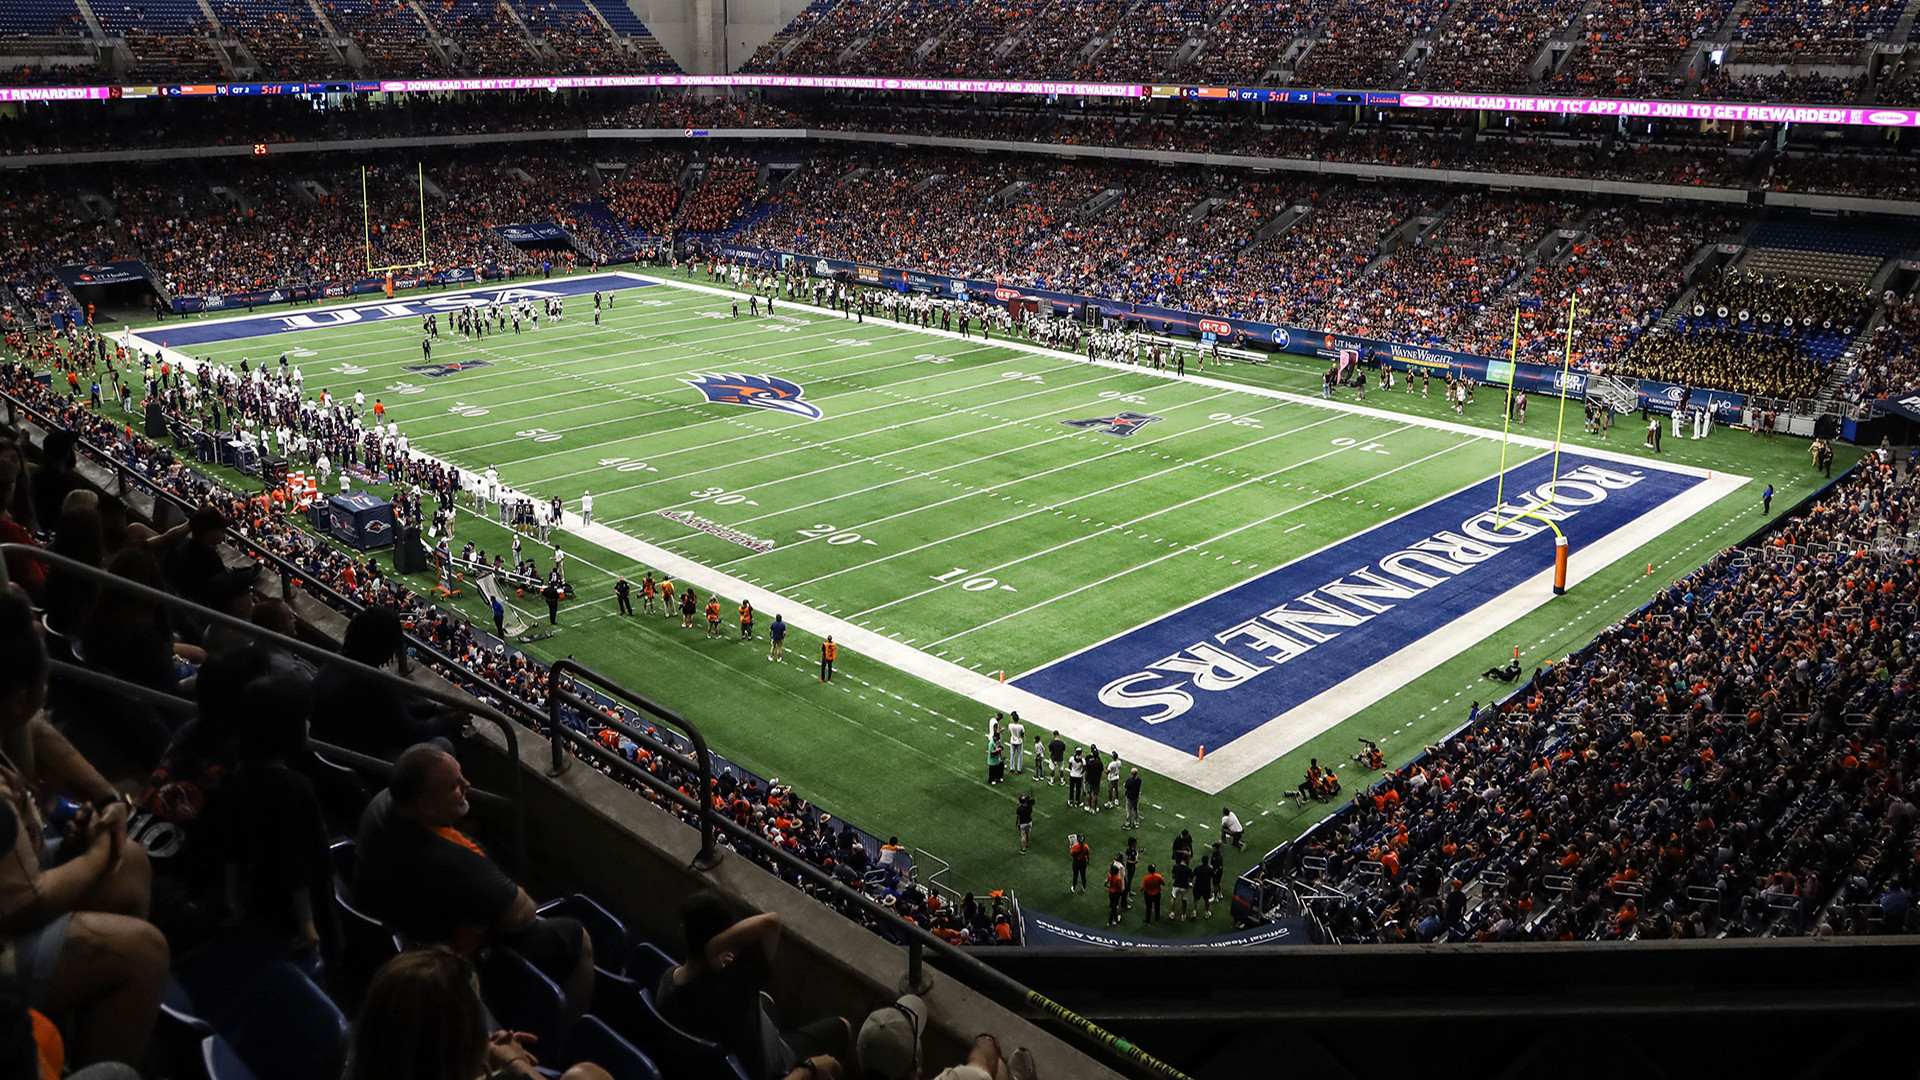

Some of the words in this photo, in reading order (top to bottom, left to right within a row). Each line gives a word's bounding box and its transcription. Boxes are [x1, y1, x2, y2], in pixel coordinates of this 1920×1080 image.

[408, 80, 460, 90] DOWNLOAD
[462, 80, 480, 89] THE
[482, 80, 496, 88] MY
[515, 80, 532, 88] APP
[534, 79, 550, 87] AND
[552, 78, 572, 86] JOIN
[572, 78, 584, 86] TO
[585, 78, 601, 86] GET
[602, 78, 648, 86] REWARDED!
[680, 76, 732, 84] DOWNLOAD
[734, 76, 750, 84] THE
[752, 76, 761, 84] MY
[773, 77, 784, 86] APP
[786, 78, 798, 86] AND
[799, 78, 814, 86] JOIN
[837, 80, 876, 88] REWARDED!
[902, 80, 942, 90] DOWNLOAD
[944, 81, 958, 90] THE
[960, 82, 972, 90] MY
[988, 82, 1004, 91] APP
[1005, 83, 1022, 92] AND
[1024, 84, 1042, 92] JOIN
[1044, 84, 1054, 92] TO
[1056, 84, 1072, 93] GET
[1074, 85, 1126, 94] REWARDED!
[11, 88, 86, 99] REWARDED!
[261, 85, 282, 94] 5:11
[1269, 92, 1289, 102] 5:11
[1432, 96, 1506, 108] DOWNLOAD
[1508, 99, 1534, 110] THE
[1537, 100, 1559, 110] MY
[1588, 102, 1617, 113] APP
[1619, 103, 1650, 114] AND
[1652, 104, 1688, 116] JOIN
[1691, 106, 1711, 118] TO
[1714, 108, 1745, 119] GET
[1748, 108, 1845, 122] REWARDED!
[254, 144, 267, 154] 25
[270, 288, 568, 330] UTSA
[1390, 345, 1452, 364] WAYNEWRIGHT
[1098, 391, 1146, 404] 30
[1718, 400, 1732, 409] VO
[1208, 413, 1256, 427] 20
[515, 428, 563, 443] 50
[1331, 437, 1384, 452] 10
[598, 458, 648, 472] 40
[690, 487, 746, 505] 30
[797, 524, 862, 545] 20
[929, 567, 998, 591] 10
[1098, 465, 1640, 725] ROADRUNNERS
[1036, 919, 1084, 938] Athletics
[1250, 927, 1288, 944] Official
[1086, 934, 1118, 946] UTSA
[1046, 1000, 1064, 1018] NOT
[1065, 1010, 1092, 1030] LEAN
[1092, 1026, 1108, 1042] SIT
[1128, 1046, 1142, 1060] OR
[1144, 1053, 1178, 1078] STAND
